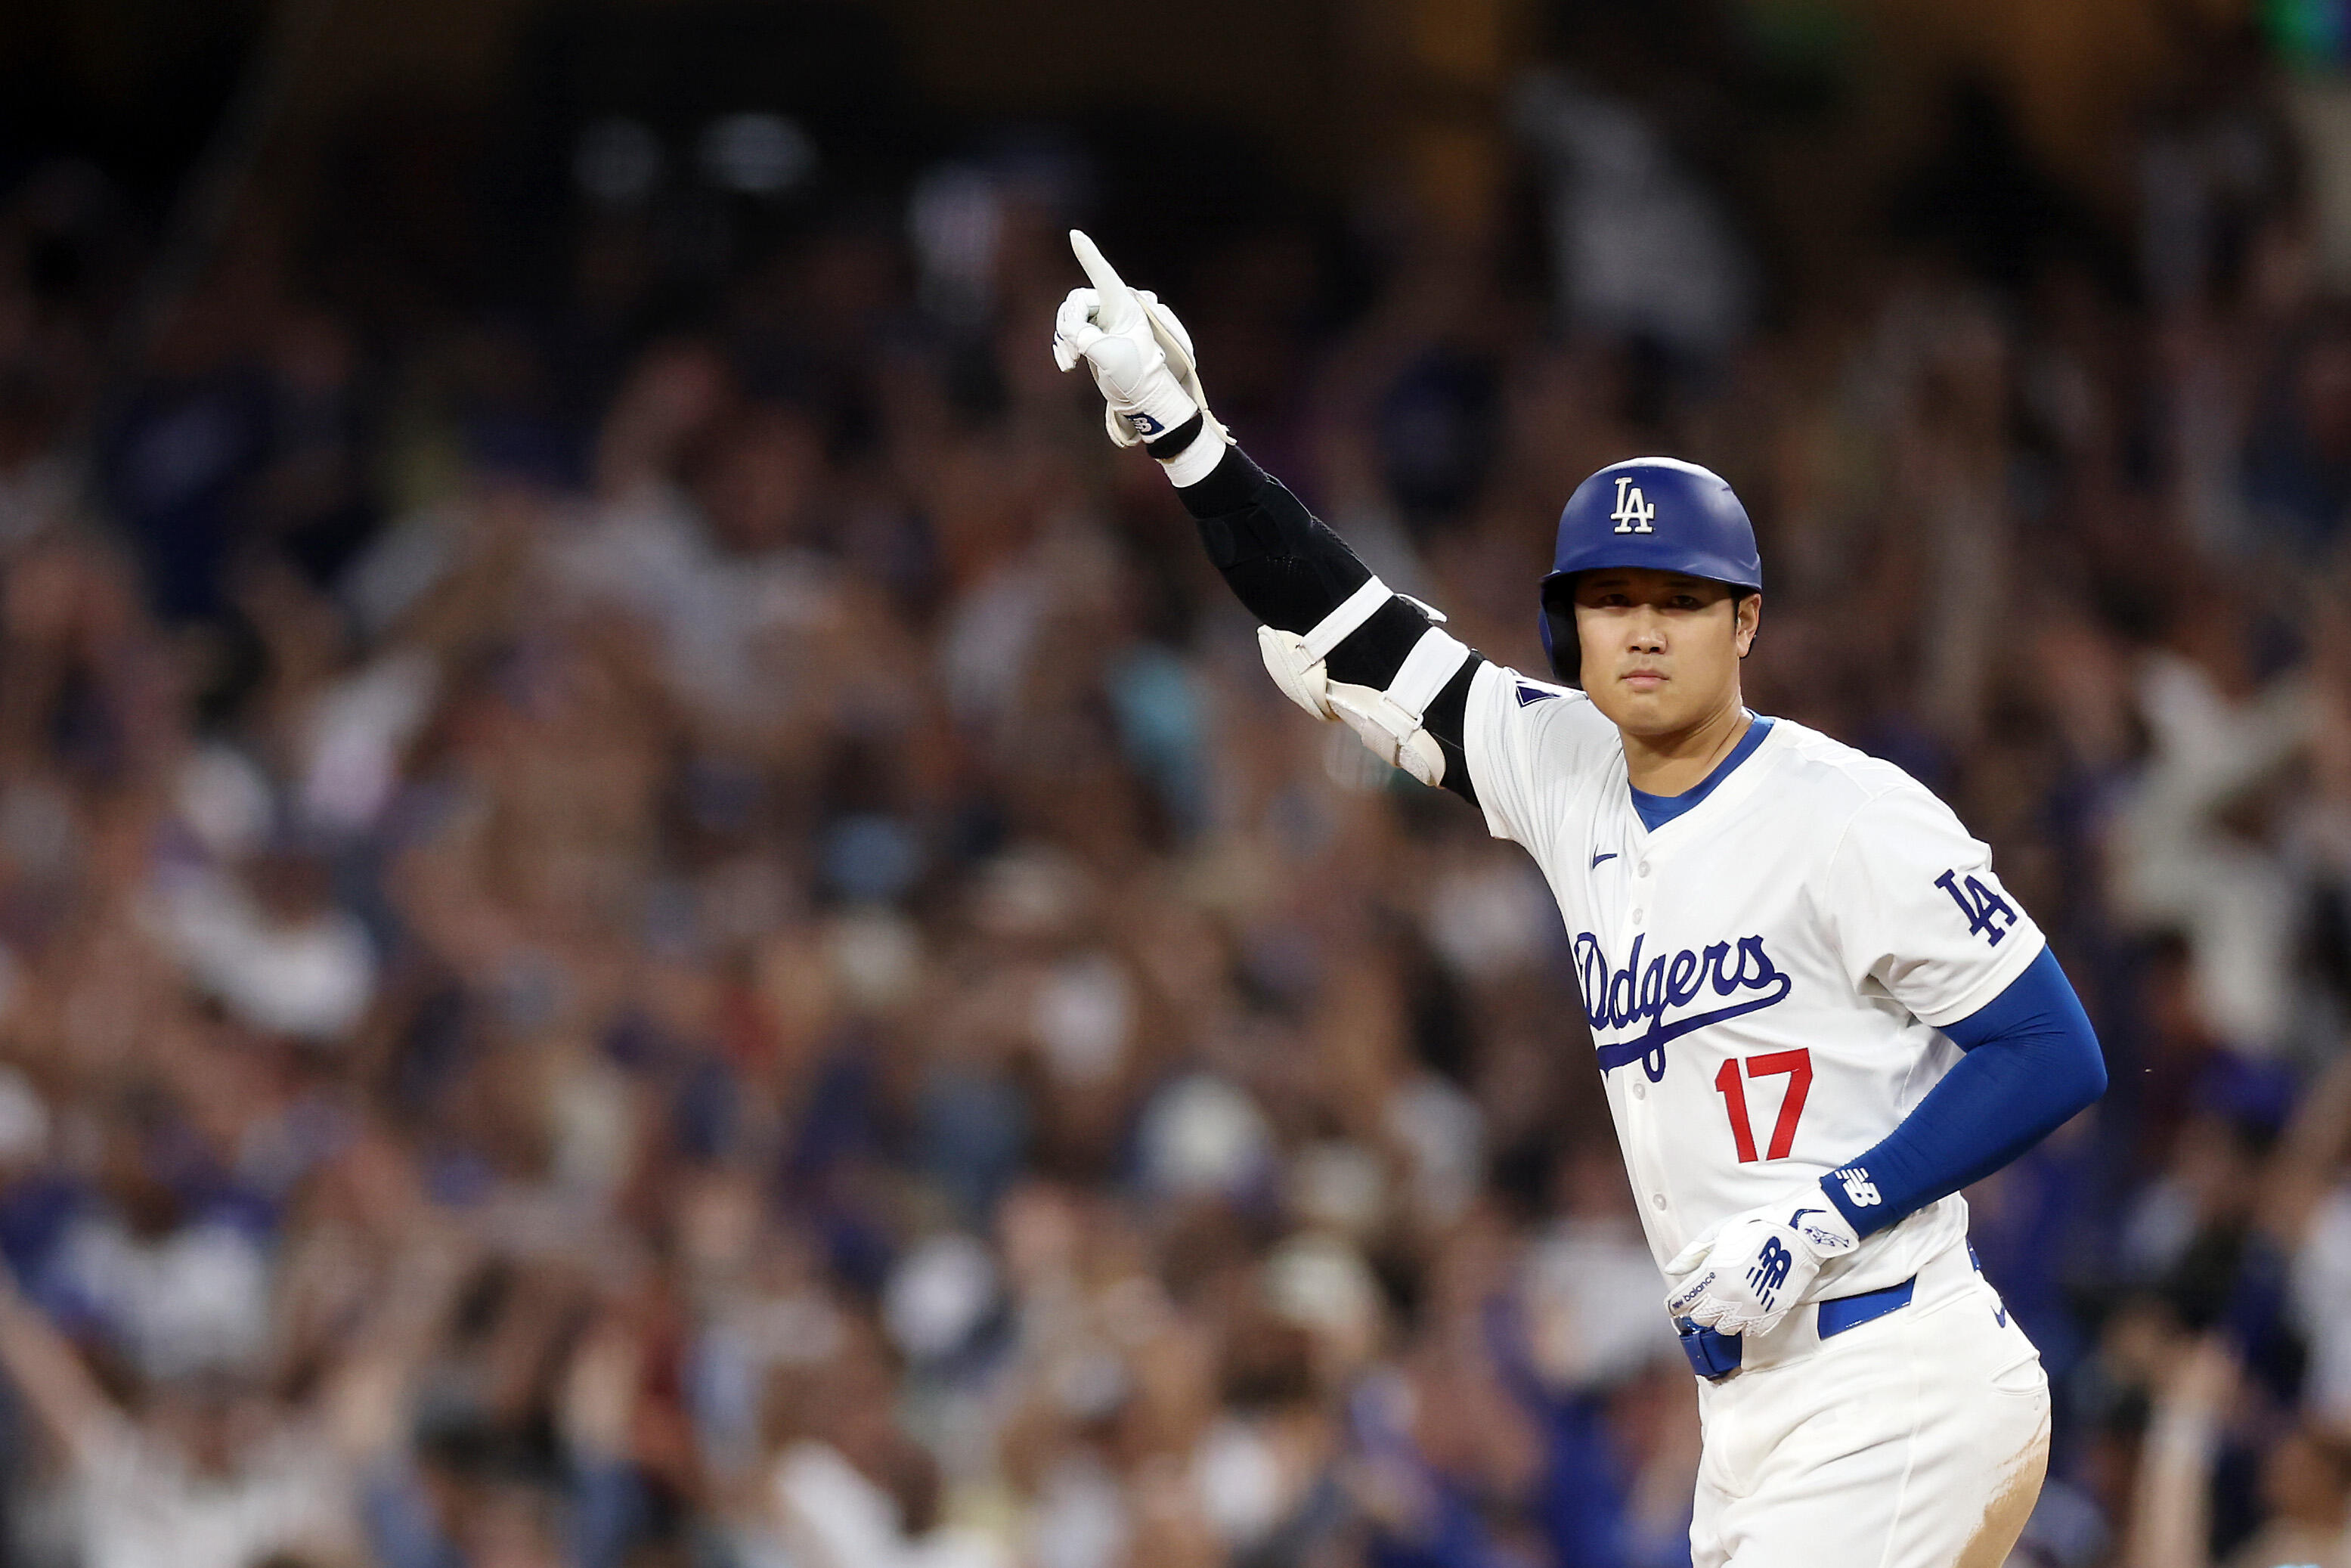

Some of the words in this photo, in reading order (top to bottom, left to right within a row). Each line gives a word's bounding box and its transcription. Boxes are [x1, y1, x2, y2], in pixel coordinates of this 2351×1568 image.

[1610, 477, 1655, 533] LA
[1934, 869, 2018, 947] LA
[1714, 1047, 1814, 1164] 17
[1682, 1272, 1716, 1302] balance
